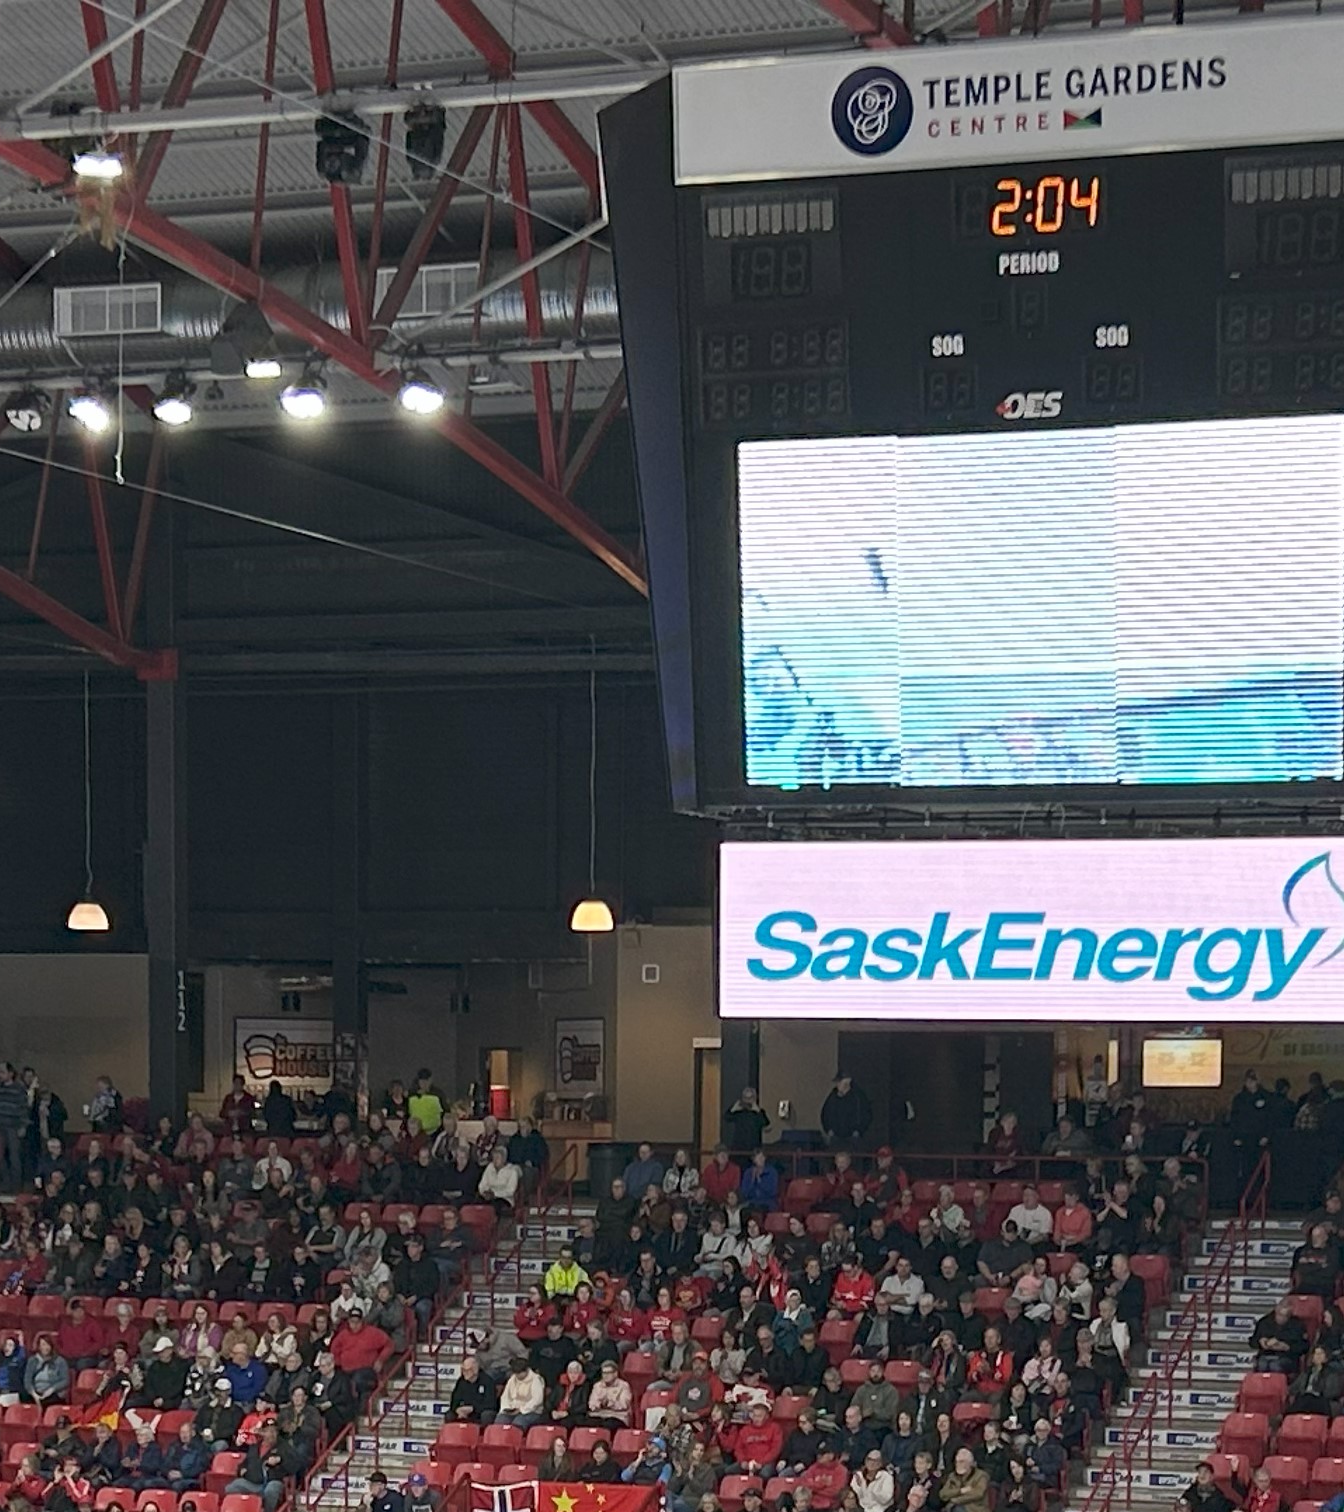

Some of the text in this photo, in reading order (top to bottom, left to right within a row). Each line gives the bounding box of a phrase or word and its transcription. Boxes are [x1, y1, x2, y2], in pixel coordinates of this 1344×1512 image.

[923, 57, 1227, 109] TEMPLE GARDENS
[928, 112, 1050, 138] CENTRE
[991, 175, 1101, 237] 2:04
[998, 251, 1060, 275] PERIOD
[746, 909, 1326, 1002] SaskEnergy
[275, 1045, 334, 1061] COFFEE
[275, 1061, 330, 1076] HOUSE
